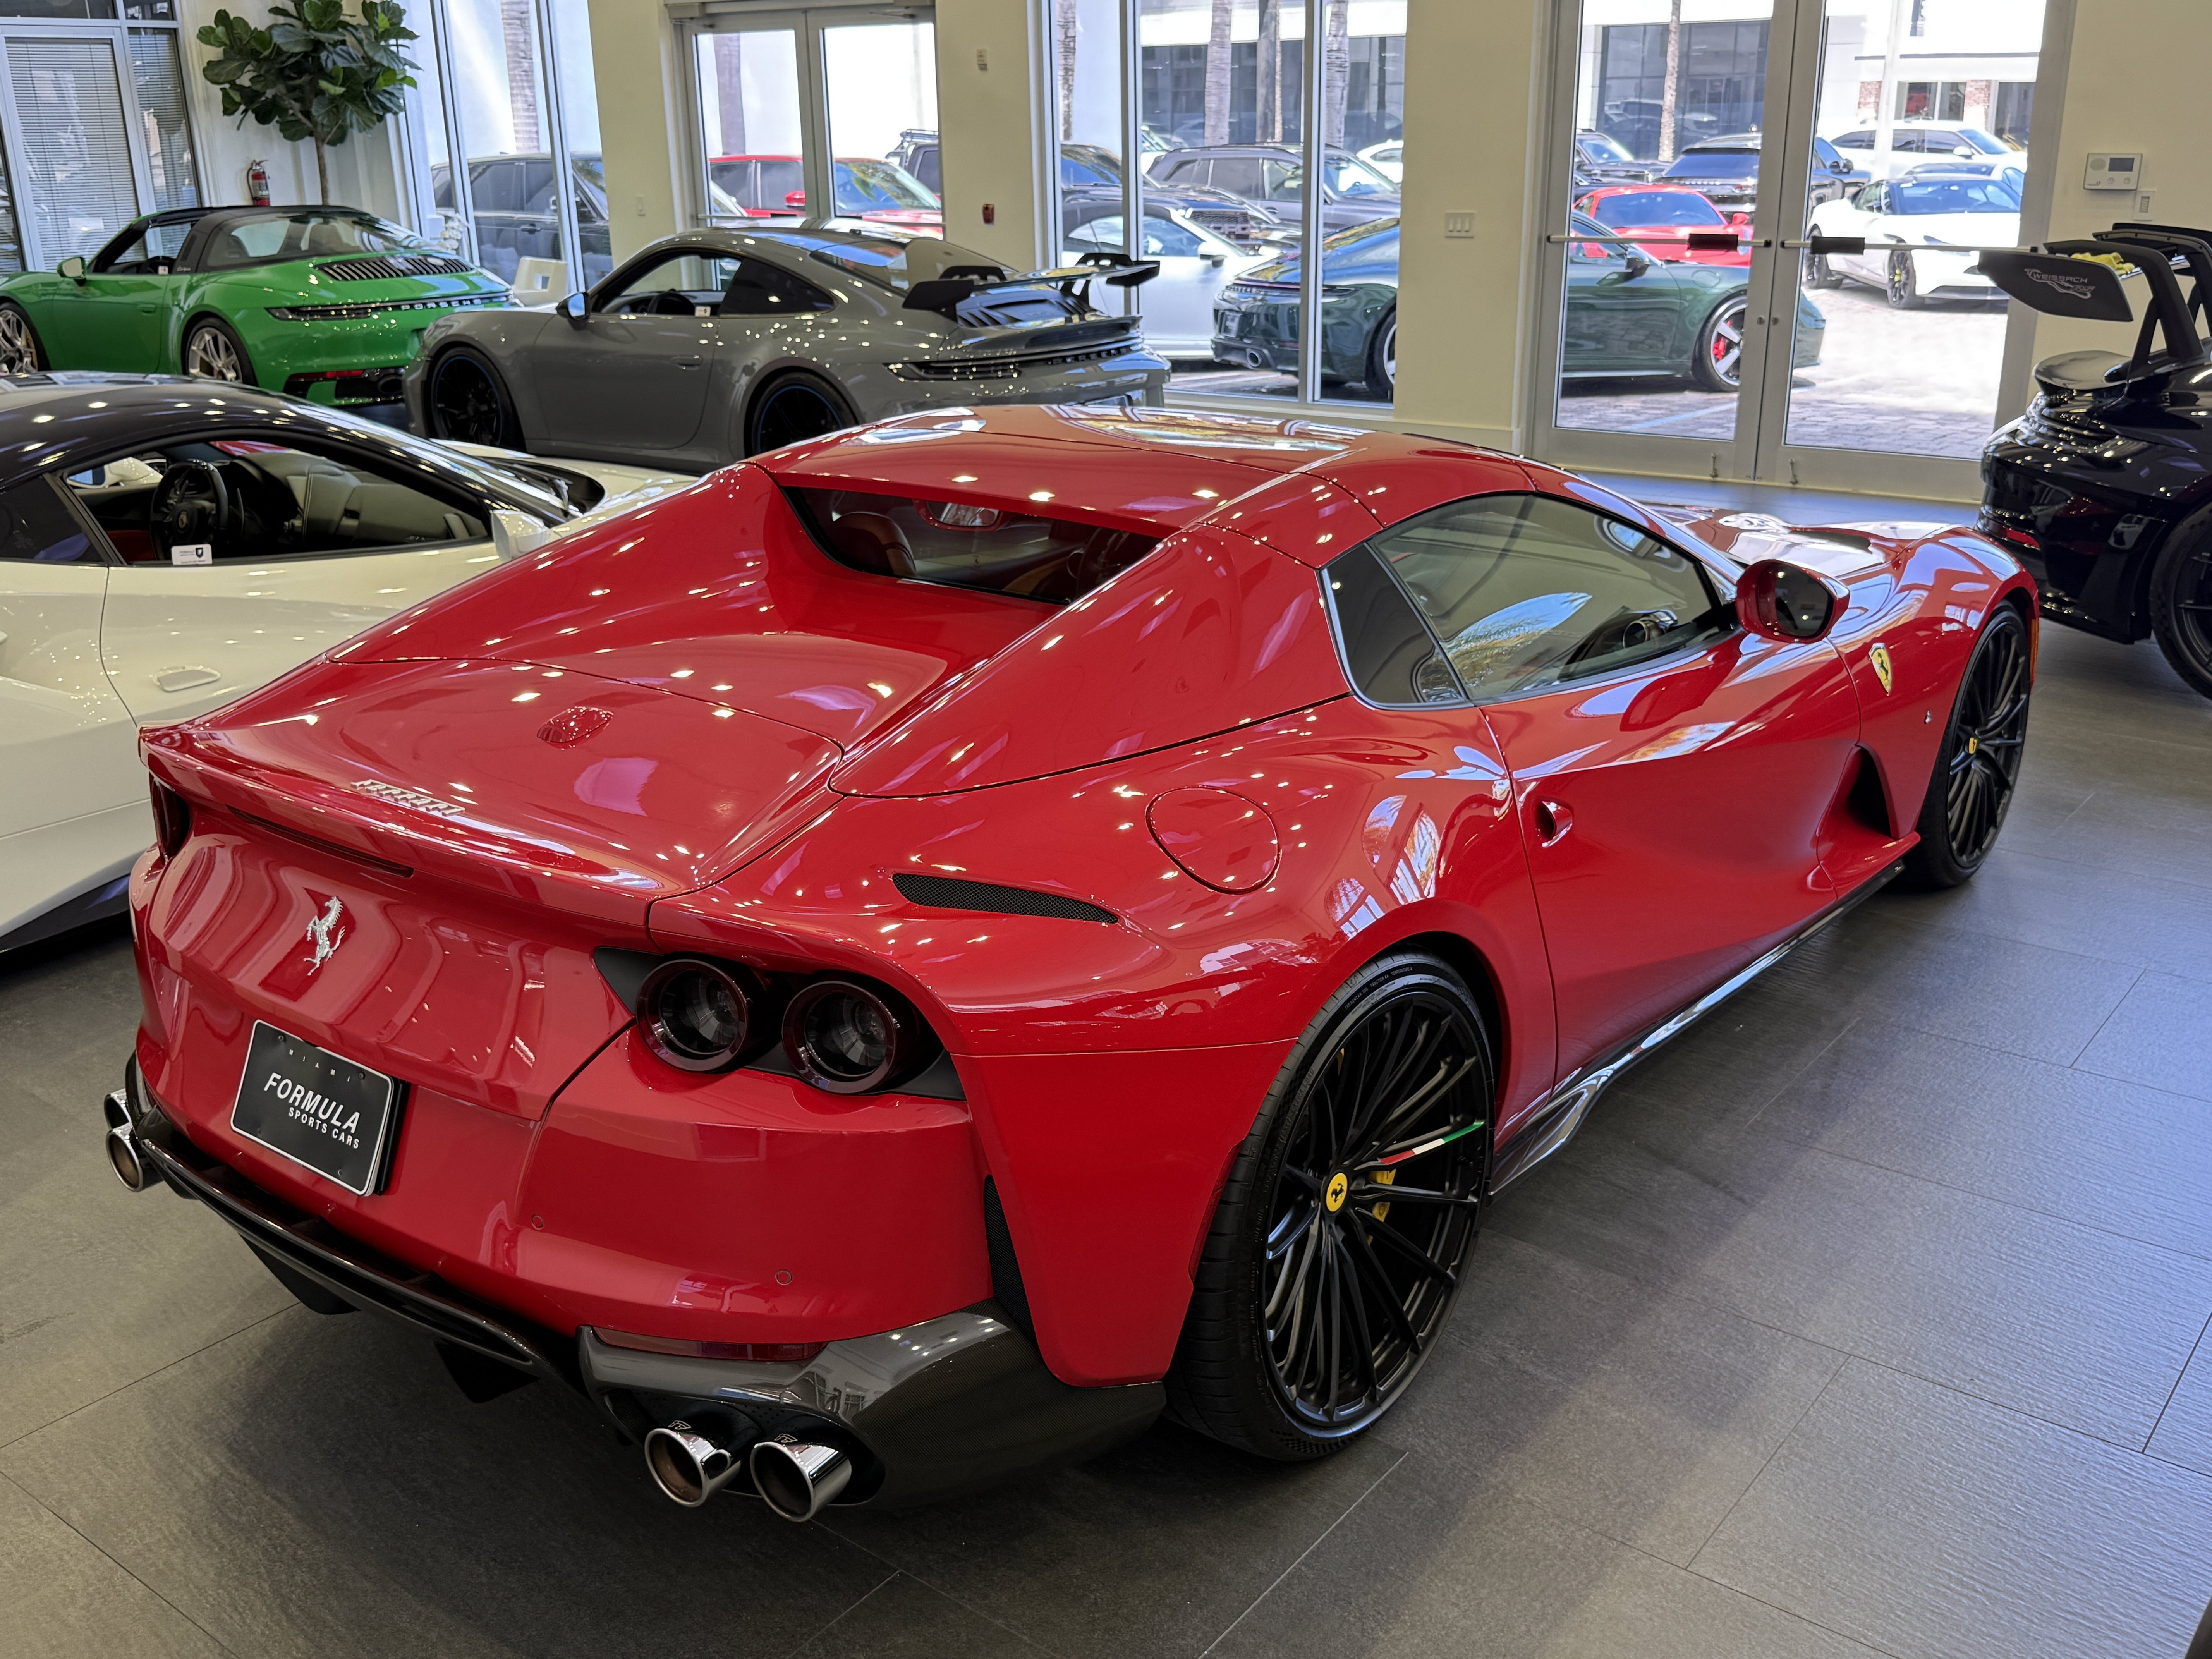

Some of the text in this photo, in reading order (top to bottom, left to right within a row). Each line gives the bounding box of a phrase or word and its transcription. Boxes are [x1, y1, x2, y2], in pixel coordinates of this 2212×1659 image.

[2033, 273, 2088, 284] WEISSACH
[350, 779, 465, 817] Ferrari
[289, 1049, 350, 1082] MIAMI
[264, 1072, 361, 1133] FORMULA
[289, 1107, 360, 1149] SPORTS CARS
